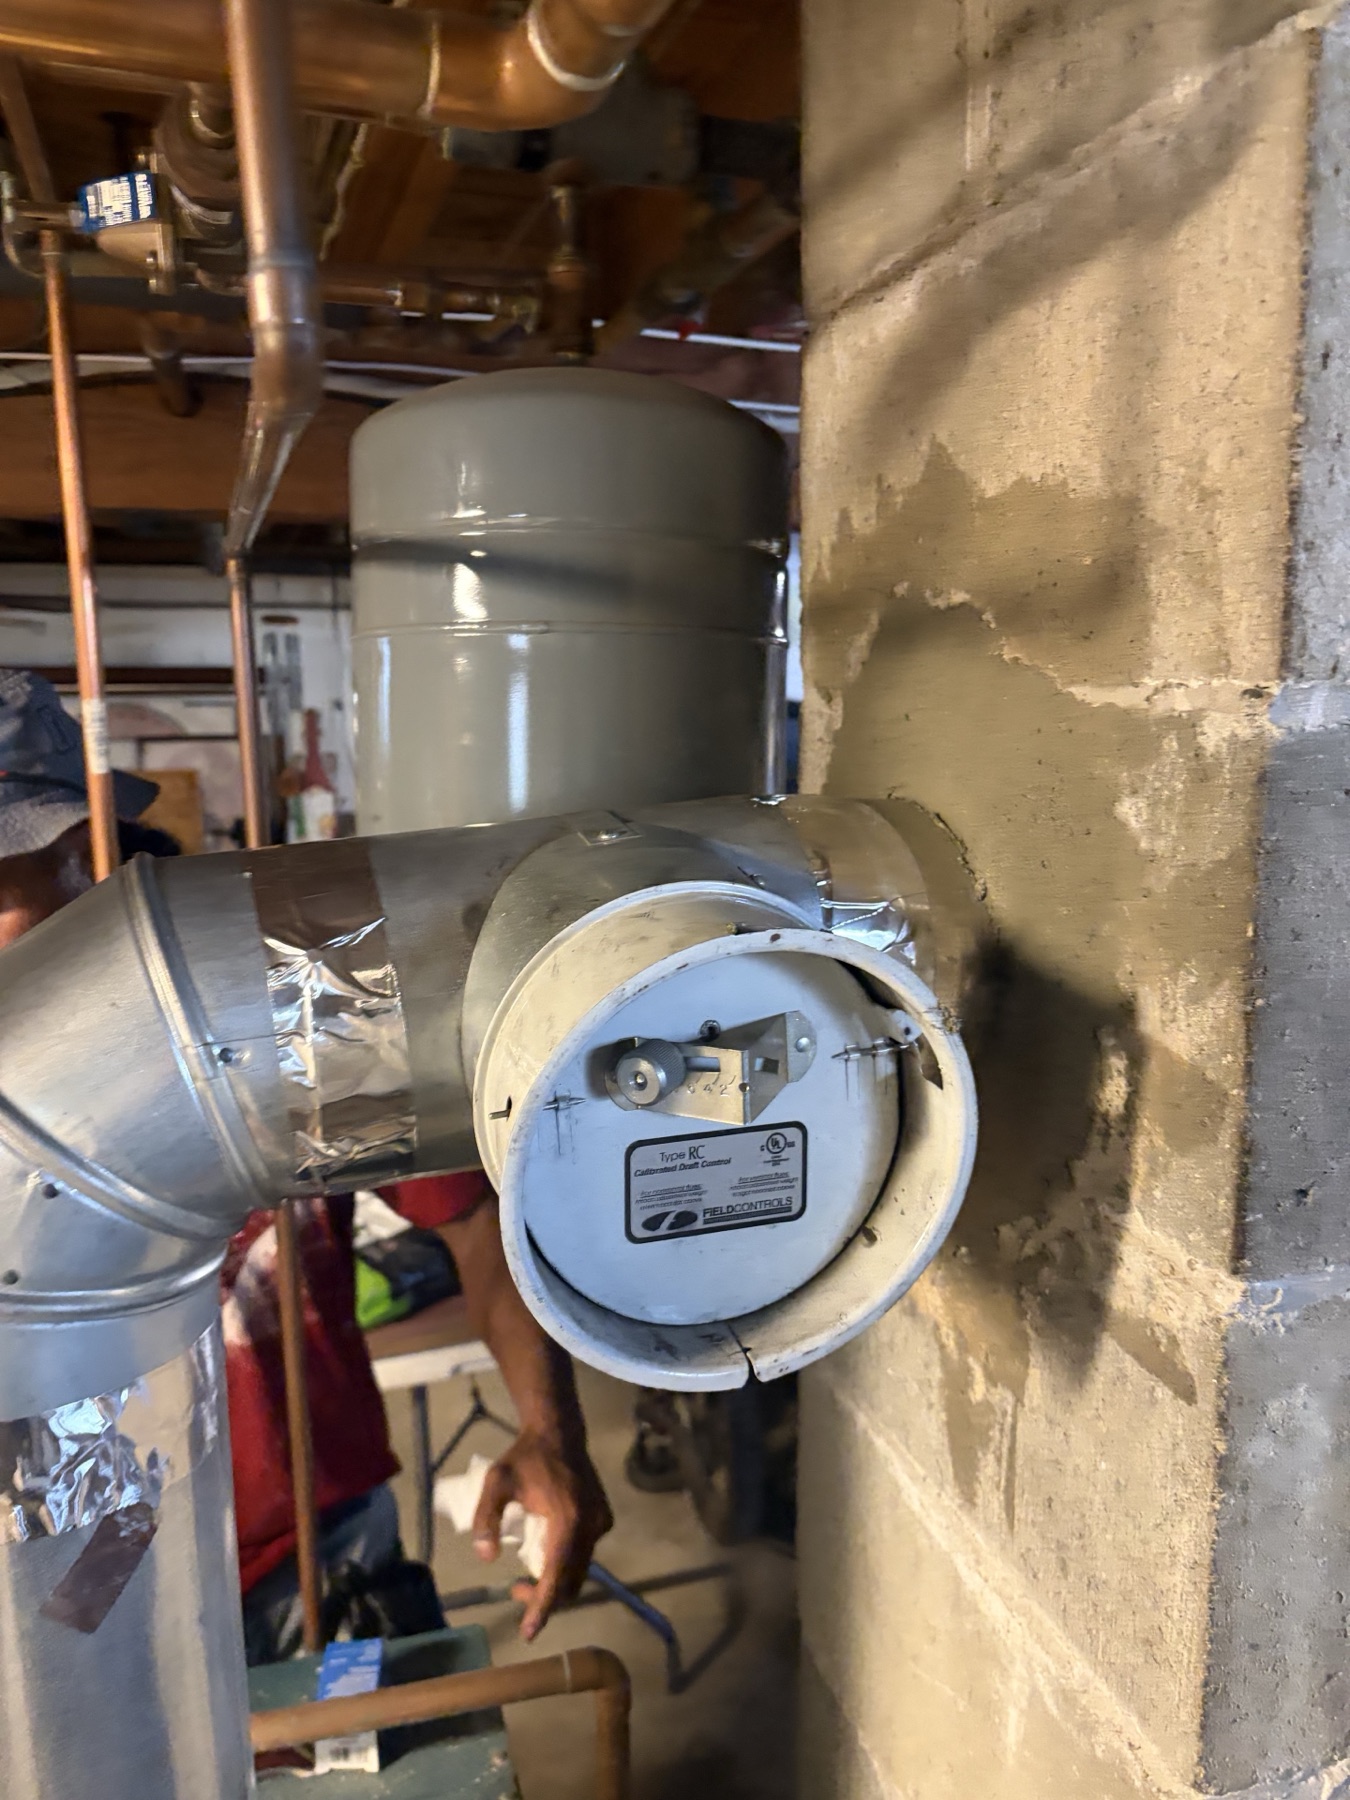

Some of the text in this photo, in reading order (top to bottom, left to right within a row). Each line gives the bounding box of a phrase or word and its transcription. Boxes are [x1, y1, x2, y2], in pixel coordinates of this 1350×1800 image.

[703, 1083, 713, 1094] 4
[720, 1084, 729, 1096] 2
[659, 1145, 705, 1163] Type RC
[634, 1157, 732, 1177] Calibrated Draft Control
